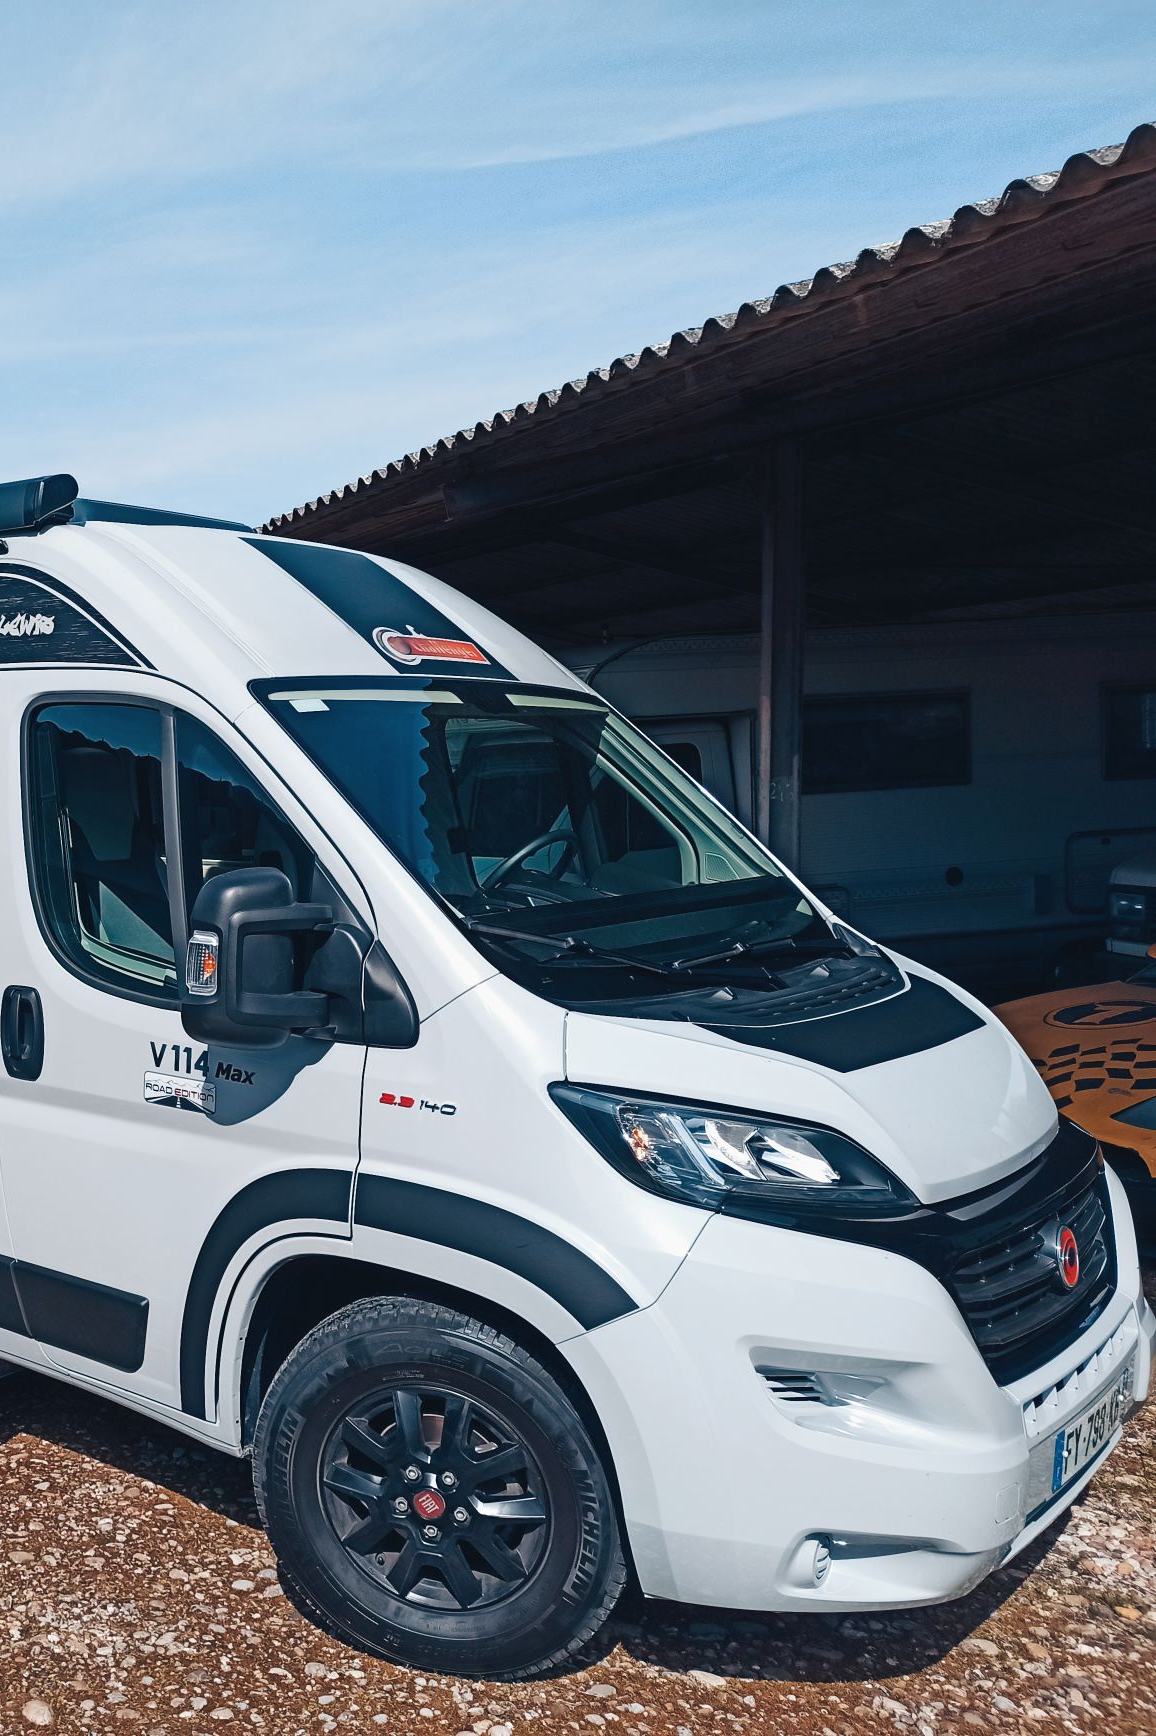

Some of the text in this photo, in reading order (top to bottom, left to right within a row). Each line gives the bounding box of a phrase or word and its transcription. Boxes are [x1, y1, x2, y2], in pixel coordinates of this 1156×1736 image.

[150, 1041, 256, 1086] V114 Max
[145, 1082, 214, 1103] ROAD EDITION
[420, 1099, 457, 1116] 140
[418, 1493, 440, 1514] FIAT
[570, 1471, 602, 1601] MICHELIN
